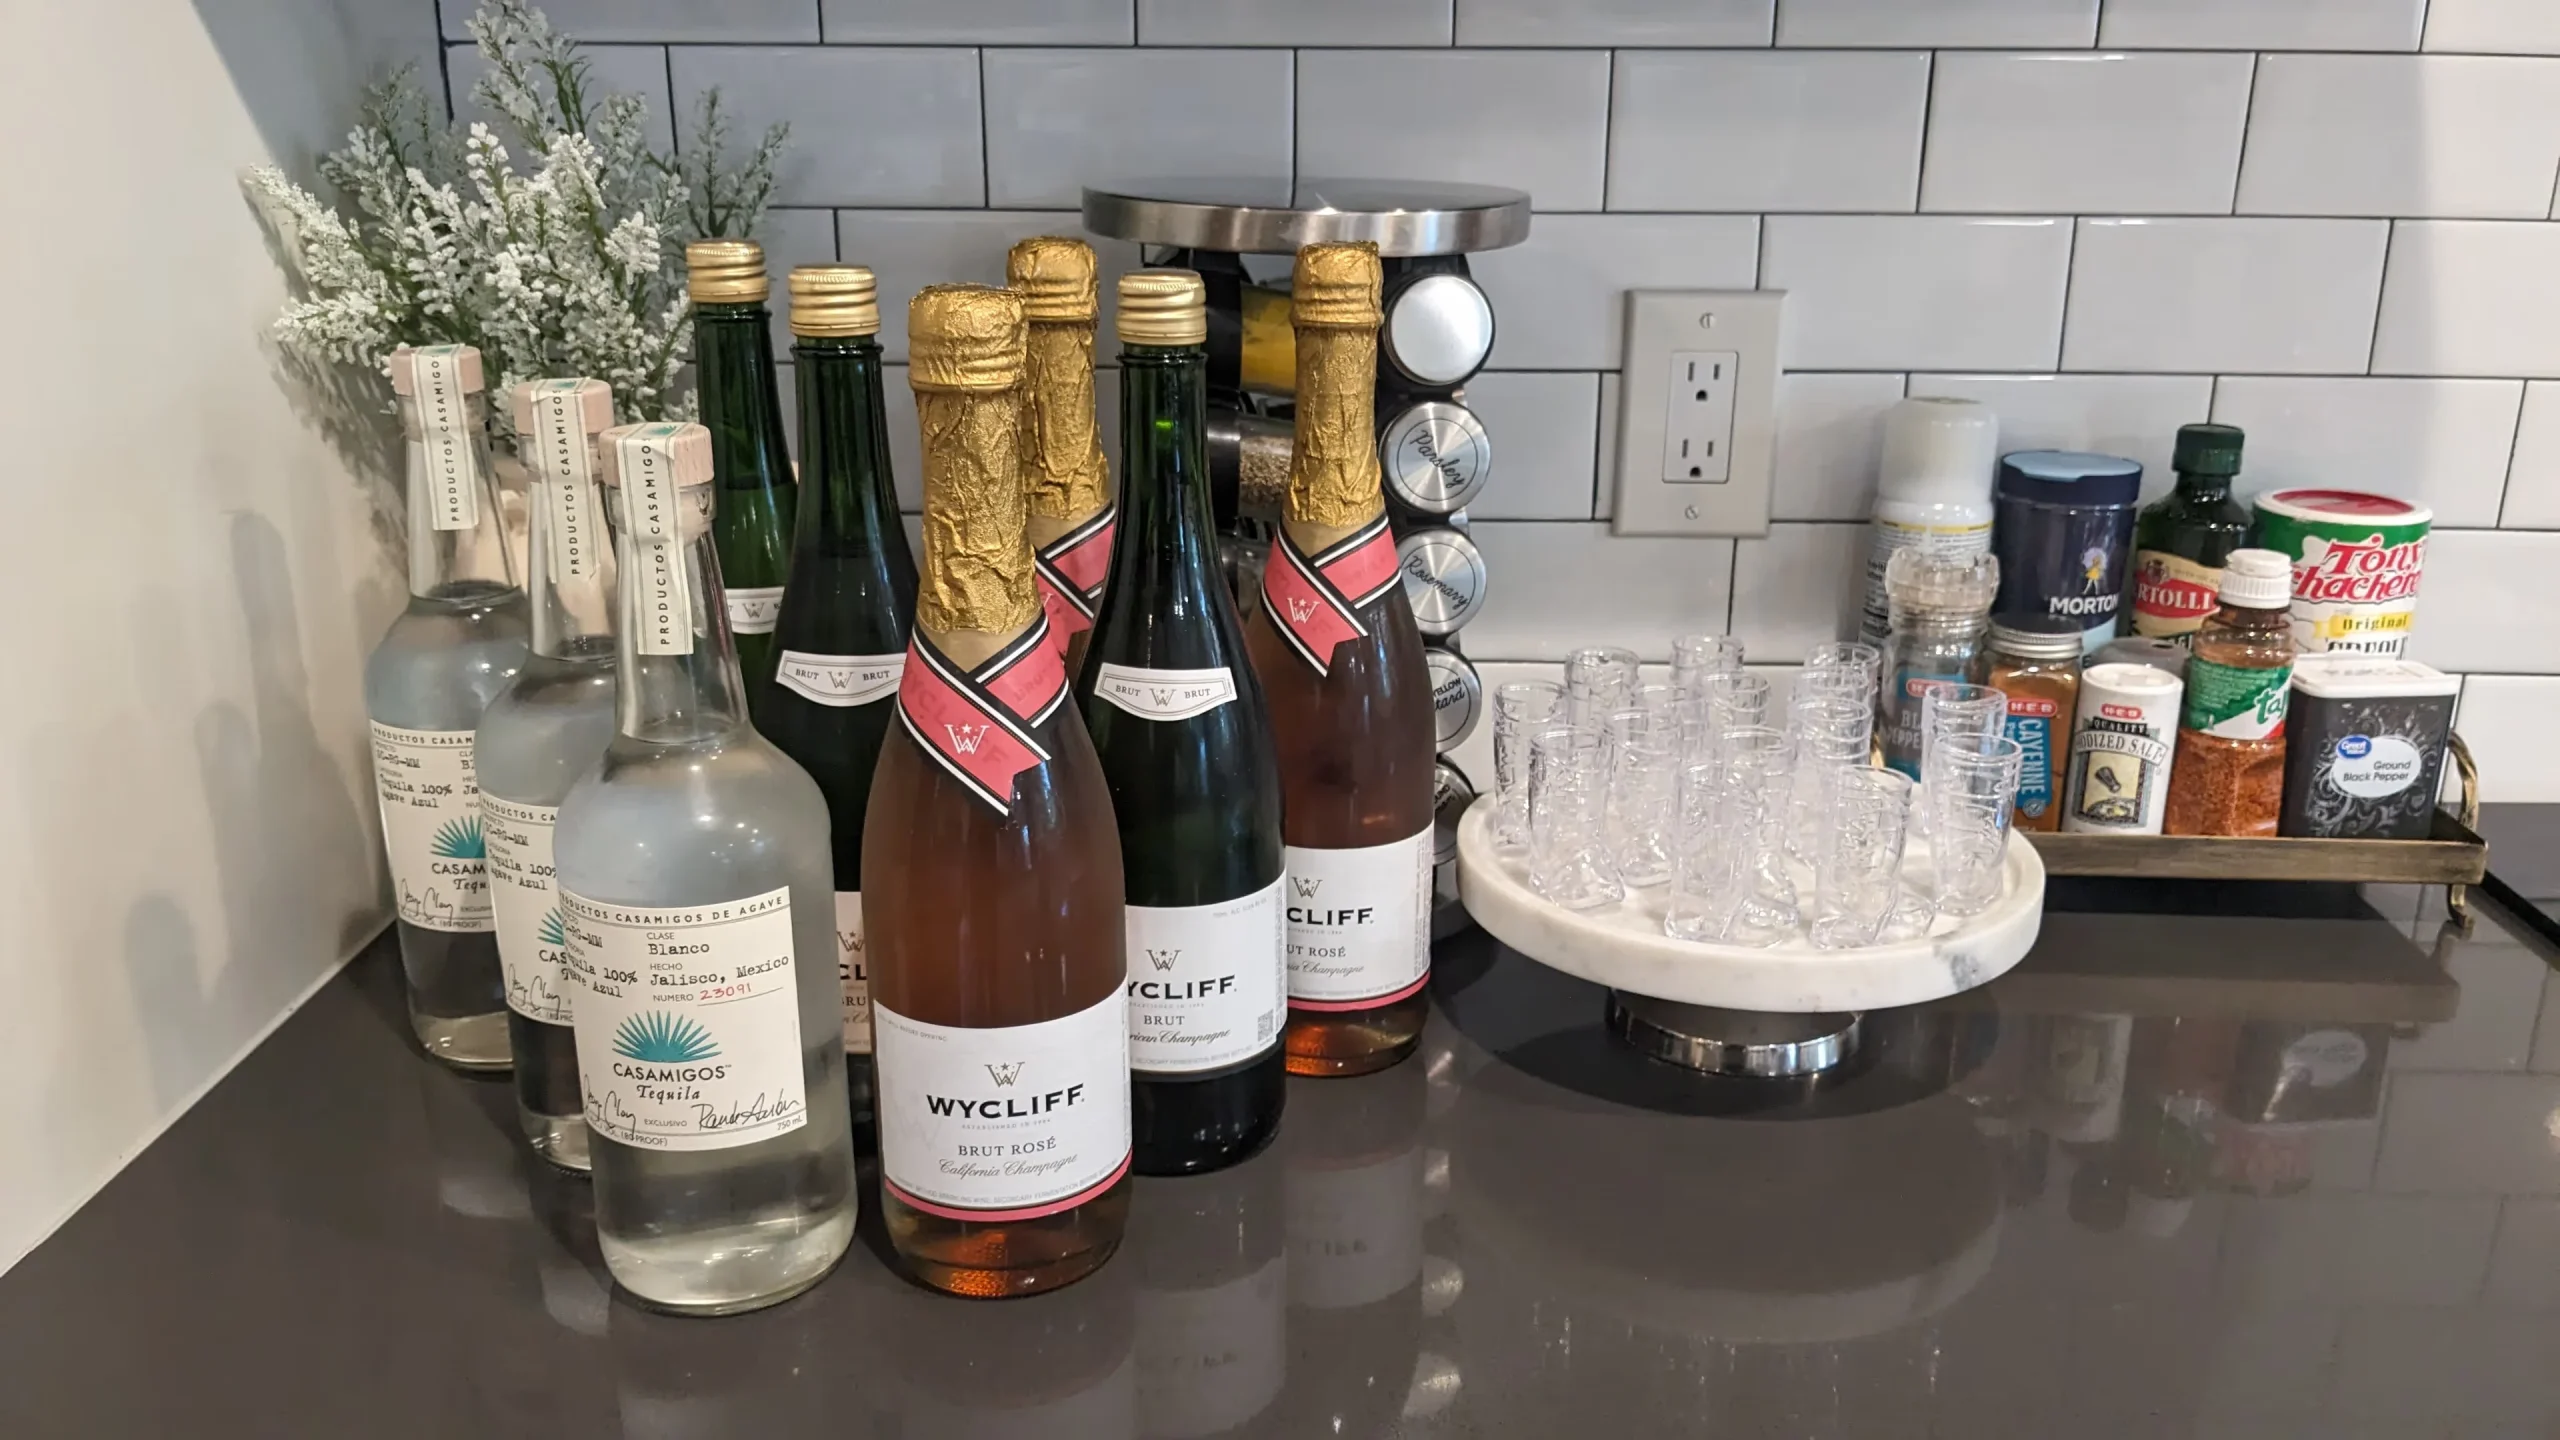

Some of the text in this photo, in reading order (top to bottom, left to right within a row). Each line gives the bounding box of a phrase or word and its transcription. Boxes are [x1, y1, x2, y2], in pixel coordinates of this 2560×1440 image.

[431, 356, 460, 522] PRODUCTOS CASAMIGO
[1409, 429, 1465, 489] Parsley
[566, 484, 580, 575] PRODUCTOS
[642, 439, 670, 645] PRODUCTOS CASAMIGO
[1404, 555, 1469, 611] Rosemary
[2293, 566, 2421, 601] hacher
[2049, 592, 2120, 616] MORTON
[2138, 583, 2211, 611] RTOLLI
[2343, 614, 2408, 631] Original
[795, 668, 820, 681] BRUT
[862, 670, 891, 681] BRUT
[1115, 684, 1142, 697] BRUT
[1184, 687, 1211, 699] BRUT
[1435, 687, 1465, 711] tard
[2255, 688, 2288, 724] taj
[2094, 719, 2145, 733] QUALITY
[431, 737, 473, 745] CASAM
[2079, 733, 2163, 761] ODIZED SALT
[2018, 719, 2045, 795] CAYENNE
[2373, 760, 2412, 770] Ground
[2343, 772, 2409, 782] Black Pepper
[421, 784, 453, 797] 100%
[411, 797, 439, 808] Azul
[431, 862, 486, 875] CASAM
[453, 878, 487, 895] Tequ
[519, 877, 548, 891] Azul
[616, 912, 702, 924] CASAMIGOS
[712, 909, 730, 920] DE
[739, 896, 783, 915] AGAVE
[1286, 907, 1373, 926] CLIFF
[646, 931, 675, 940] CLASE
[648, 943, 710, 956] Blanco
[1287, 944, 1347, 958] UT ROSÉ
[604, 967, 638, 985] 100%
[650, 963, 683, 971] HECHO
[650, 955, 789, 987] Jalisco, Mexico
[1301, 961, 1364, 978] Champagne
[593, 981, 623, 998] Azul
[653, 982, 752, 1002] NUMERO 23091
[1128, 974, 1236, 999] YCLIFF
[842, 996, 867, 1007] RU
[1144, 1015, 1185, 1026] BRUT
[1130, 1029, 1231, 1047] rican Champagne
[613, 1062, 726, 1082] CASAMIGOS
[636, 1085, 701, 1106] Tequila
[644, 1118, 688, 1127] EXCLUSIVO
[958, 1136, 1057, 1157] BRUT ROSÉ
[939, 1153, 1079, 1180] California Champagne
